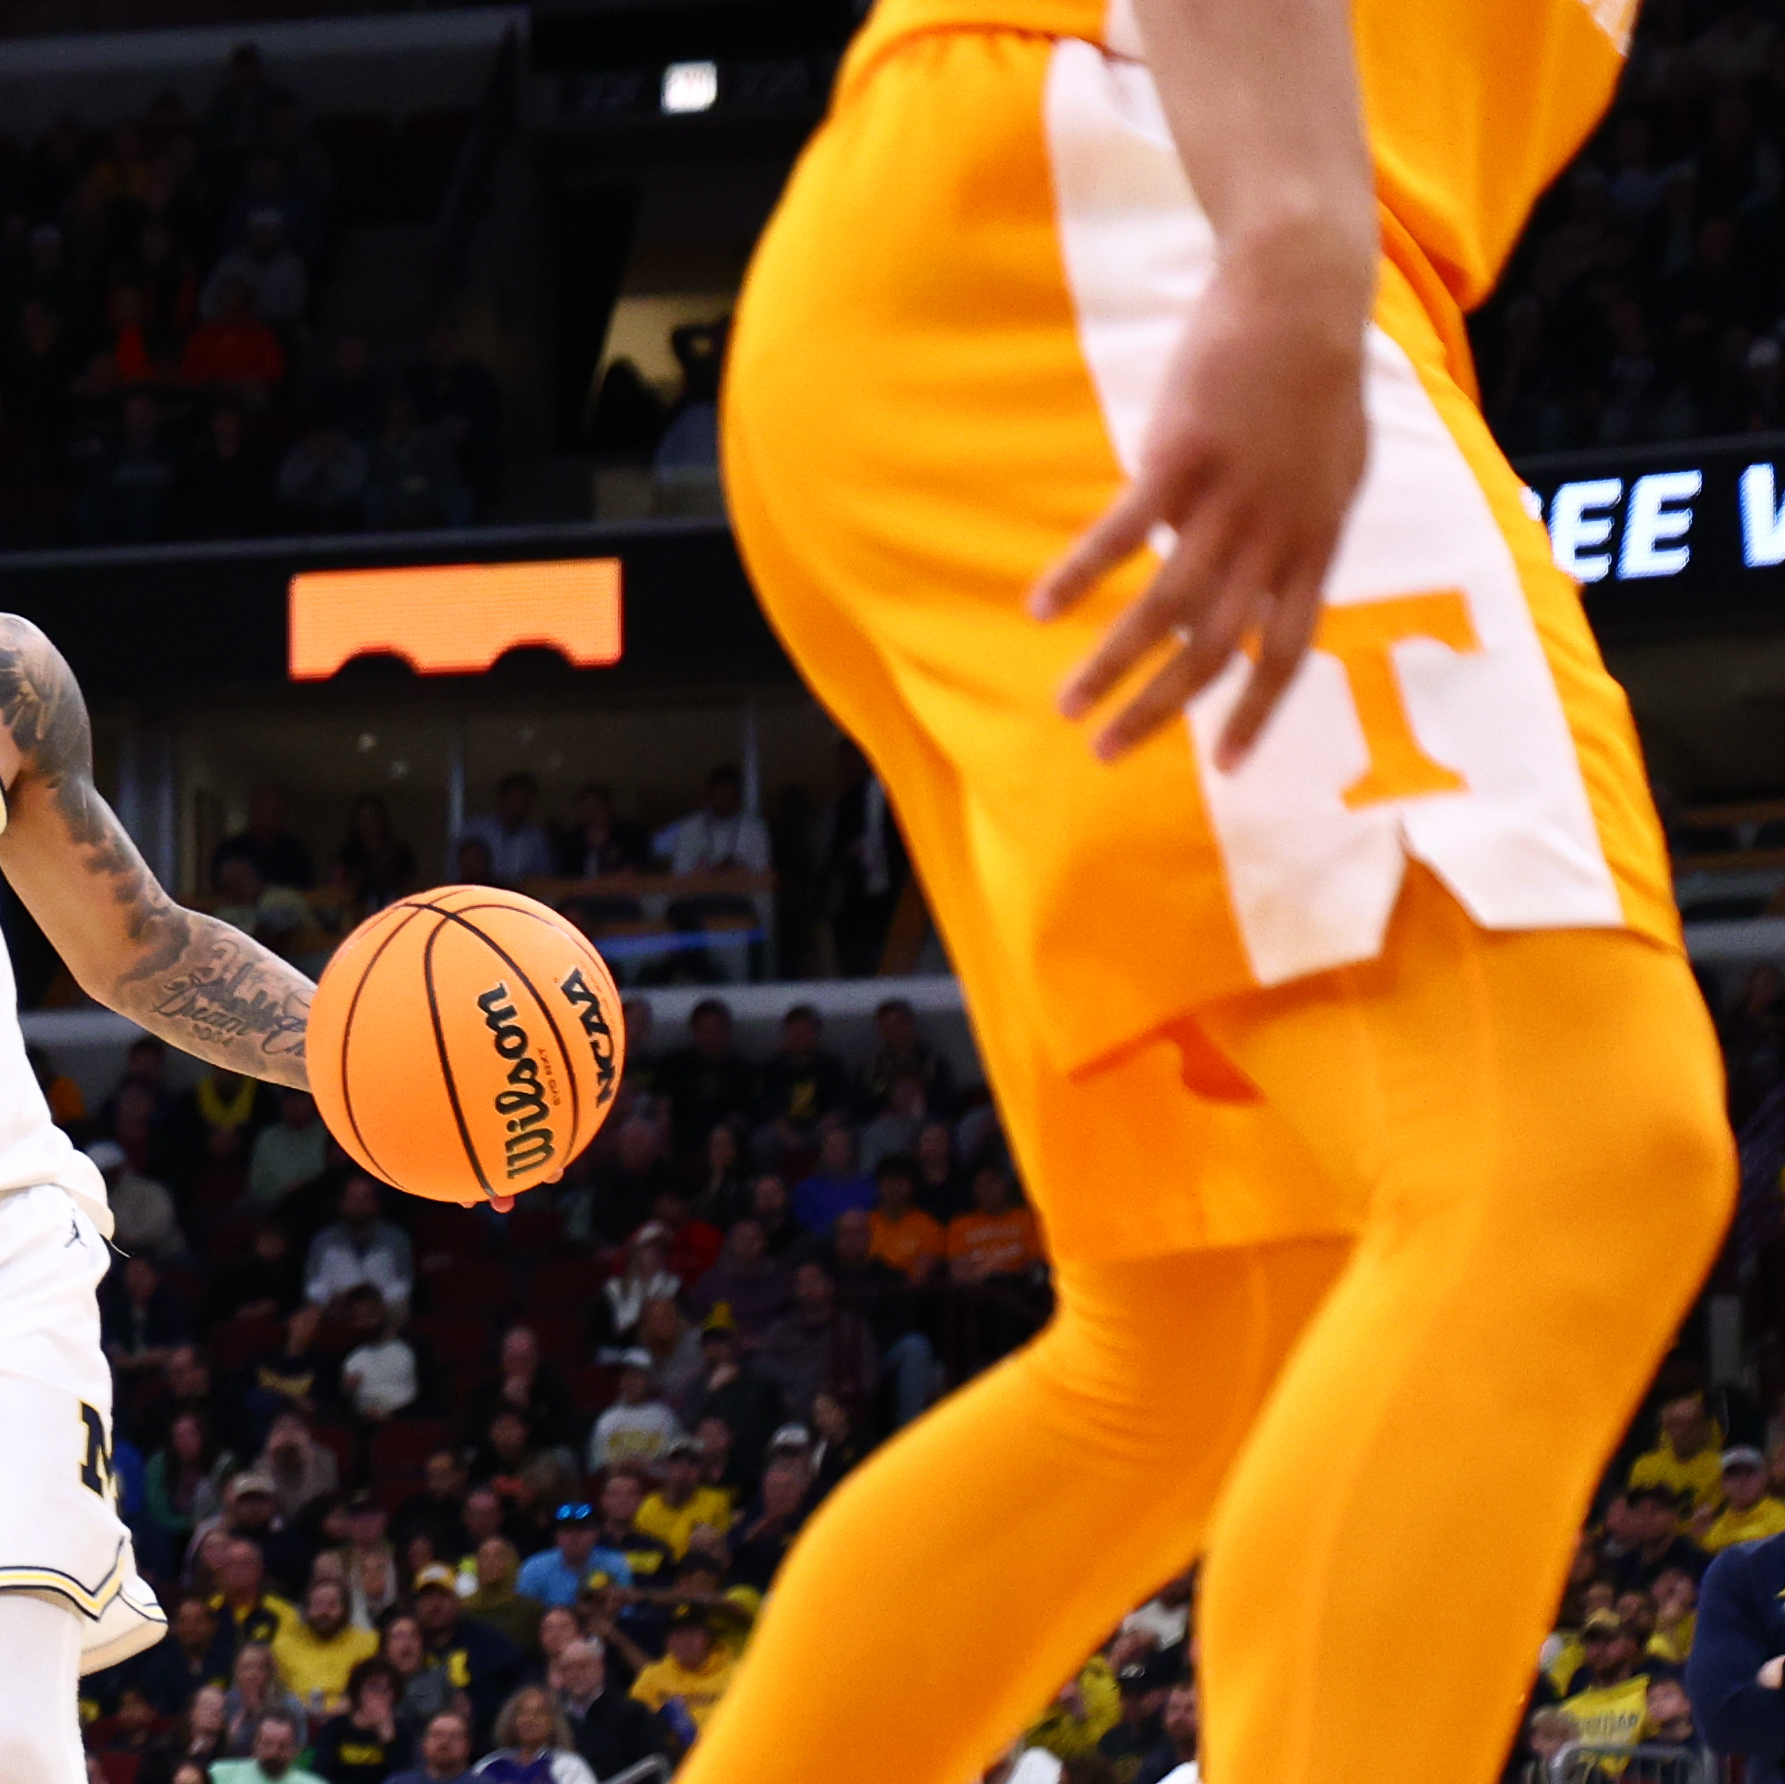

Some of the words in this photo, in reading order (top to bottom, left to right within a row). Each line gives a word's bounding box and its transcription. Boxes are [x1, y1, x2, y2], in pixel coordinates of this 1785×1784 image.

[1521, 469, 1703, 584] EE
[1304, 586, 1485, 812] T
[477, 982, 555, 1180] Wilson
[561, 966, 615, 1109] NCAA
